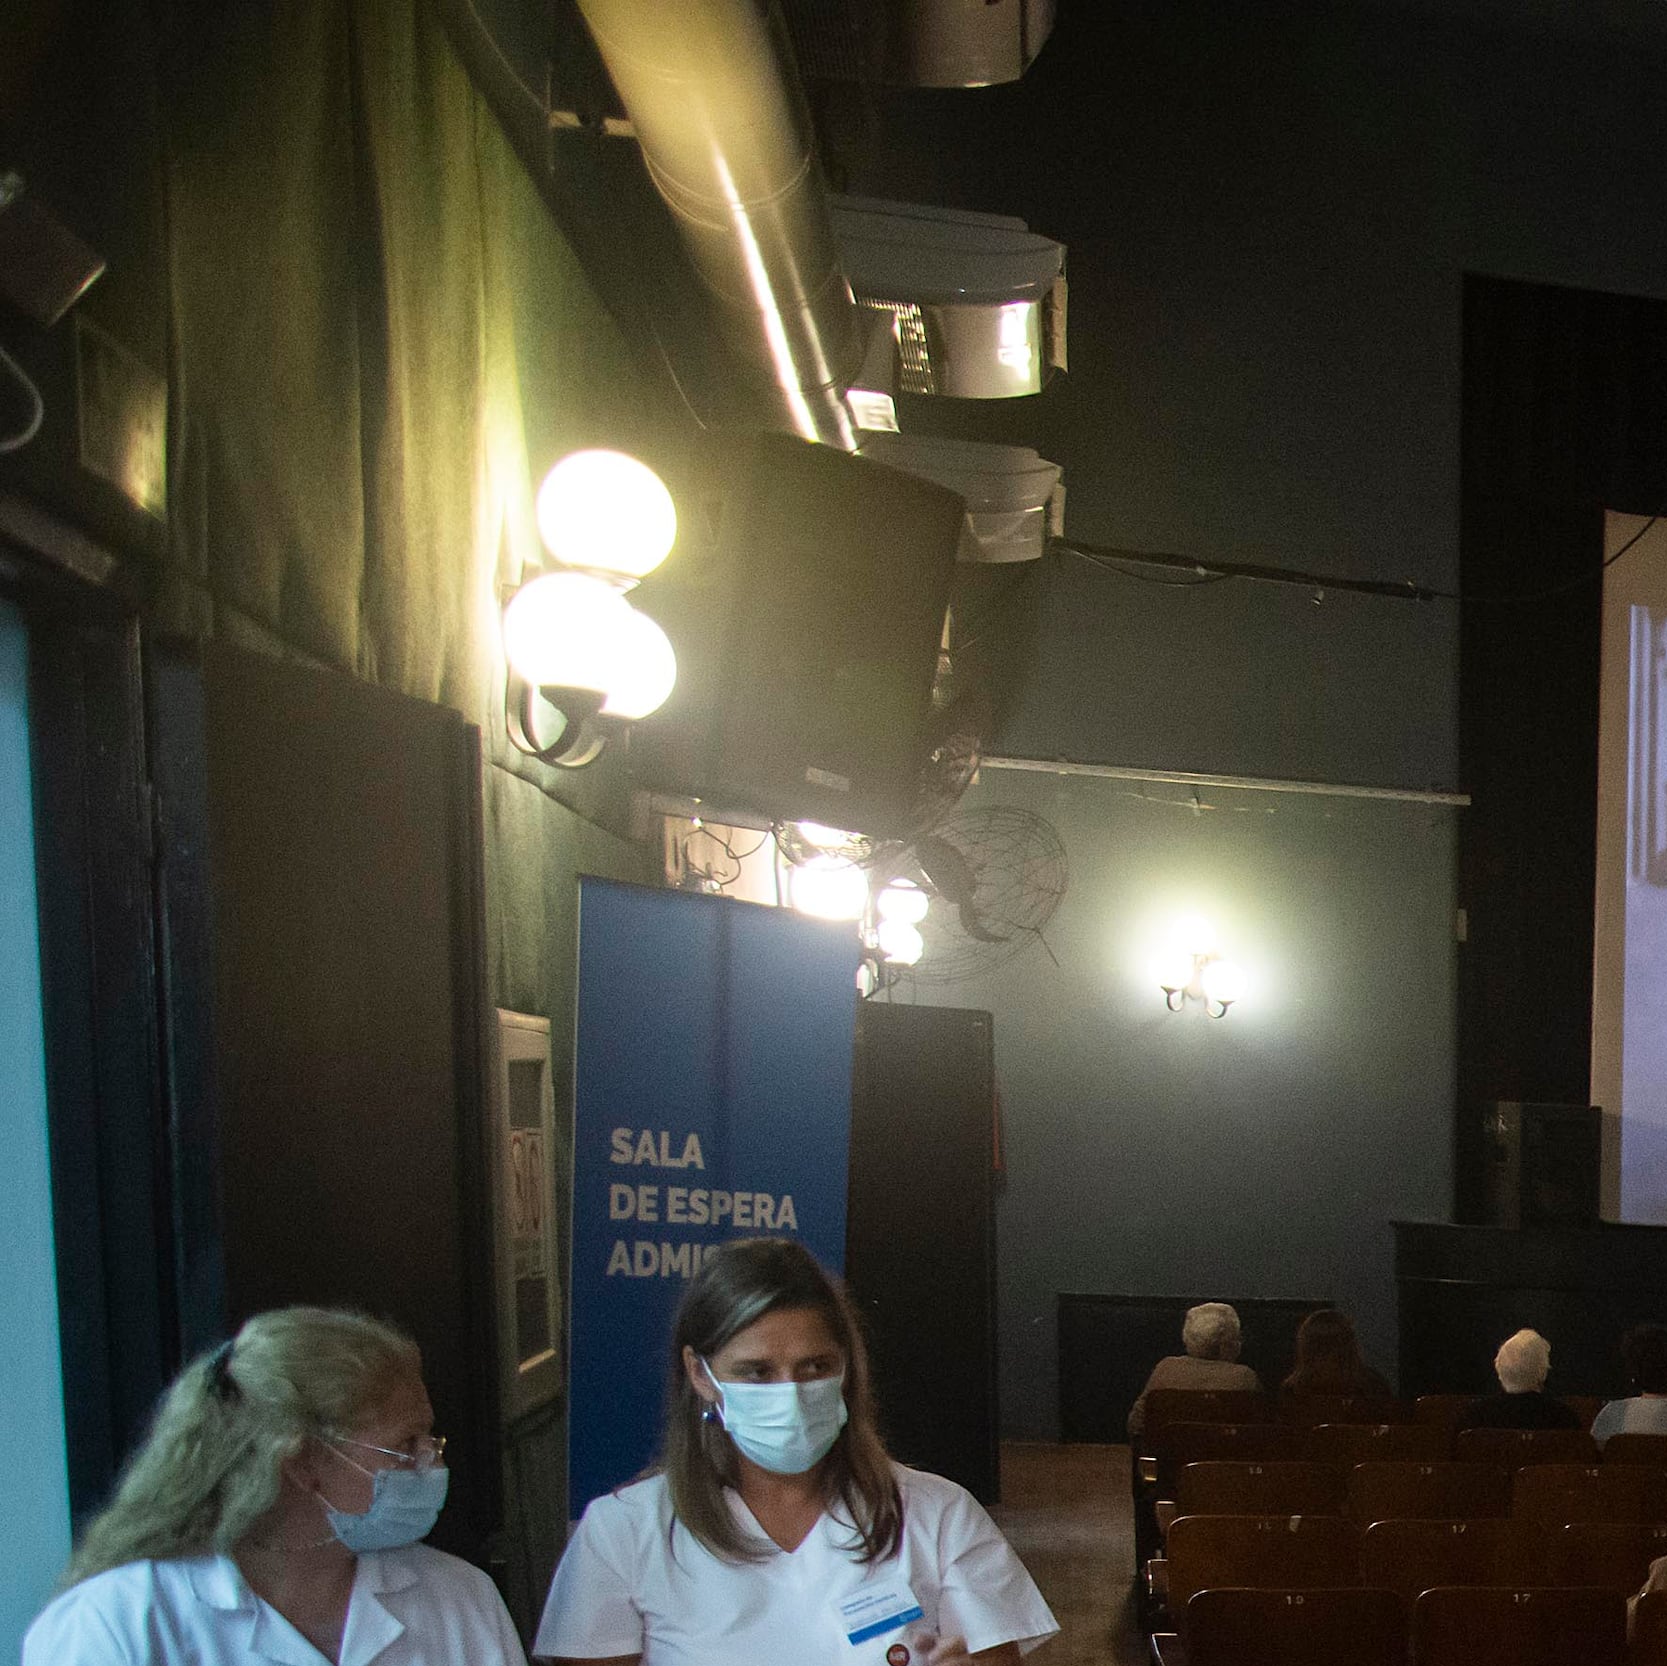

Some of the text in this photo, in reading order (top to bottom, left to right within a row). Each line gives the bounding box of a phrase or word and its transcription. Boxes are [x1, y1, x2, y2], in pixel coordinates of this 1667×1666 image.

[609, 1127, 705, 1170] SALA
[609, 1183, 798, 1230] DE ESPERA
[1513, 1593, 1531, 1603] 17
